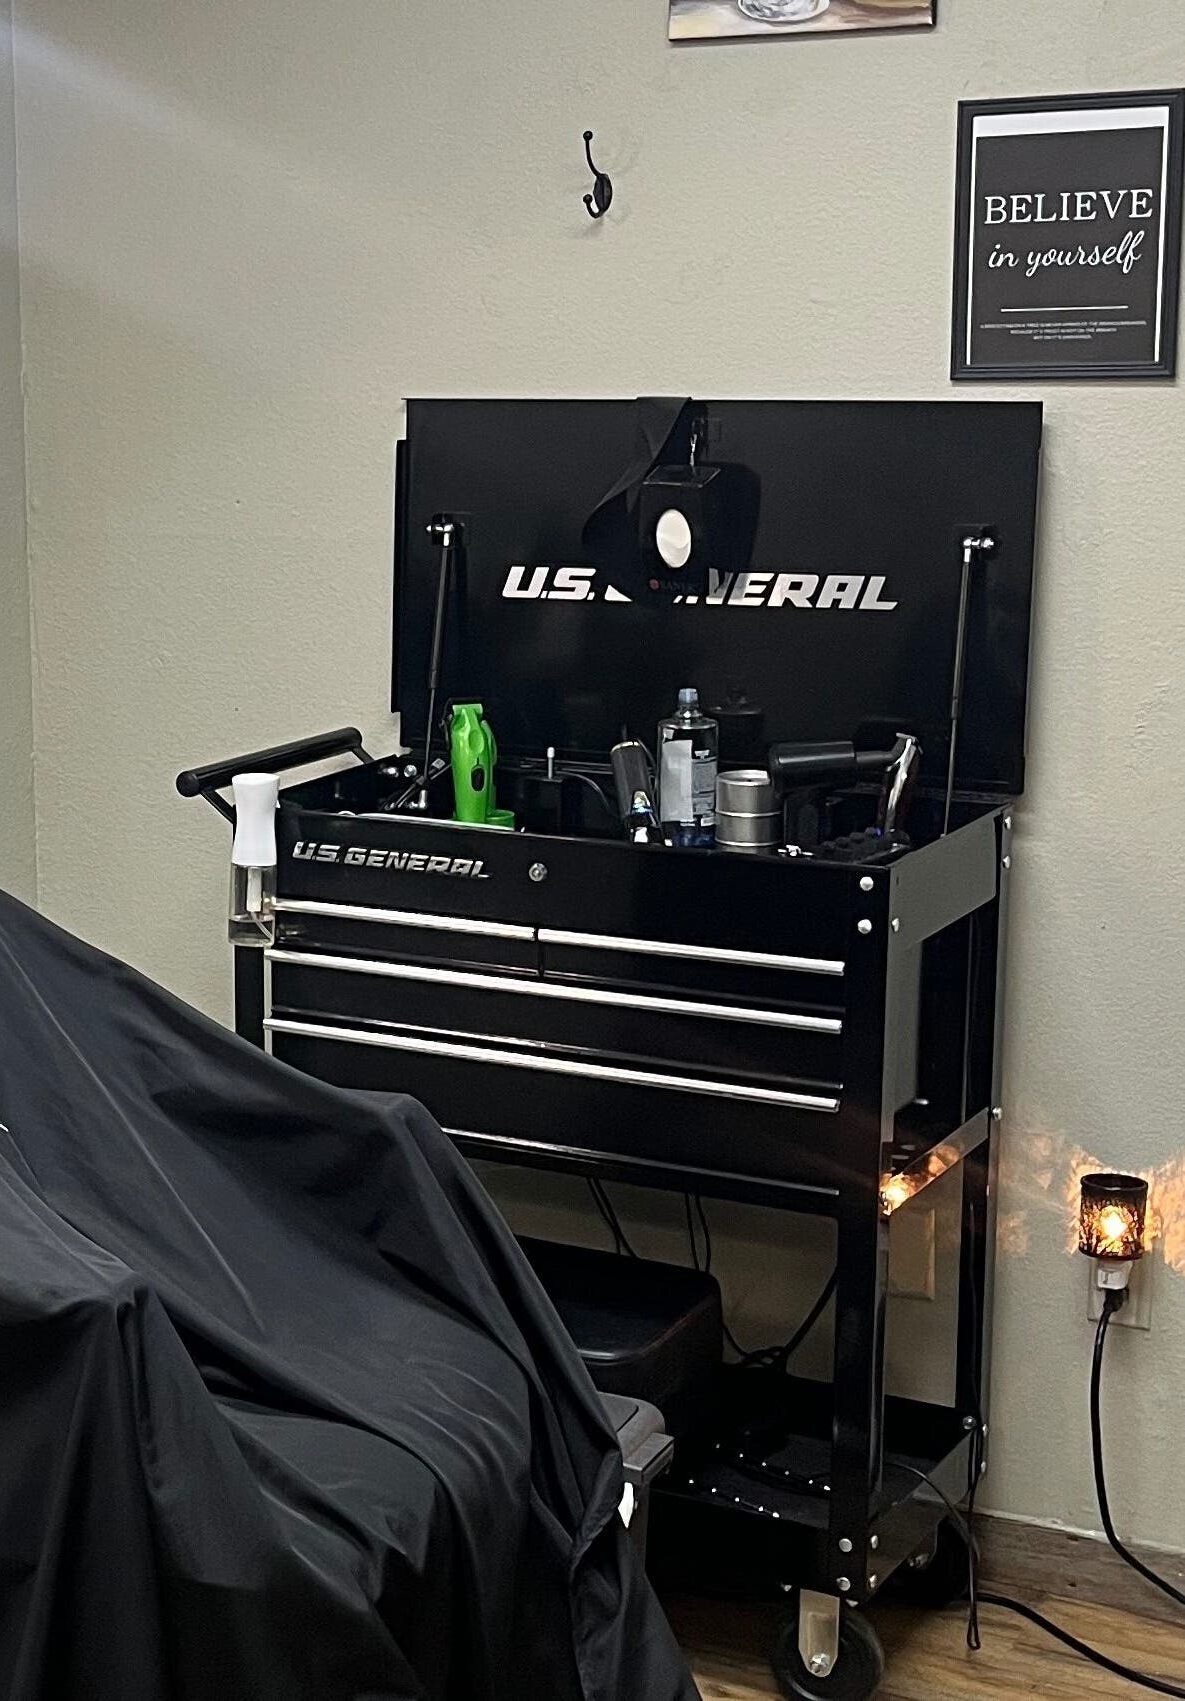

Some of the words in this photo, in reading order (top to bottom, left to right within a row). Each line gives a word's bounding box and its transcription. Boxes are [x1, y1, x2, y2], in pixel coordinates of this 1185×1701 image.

[984, 188, 1153, 224] BELIEVE
[988, 244, 1019, 267] in
[1025, 230, 1145, 277] yourself
[501, 565, 597, 601] U.S.
[343, 847, 490, 879] GENERAL
